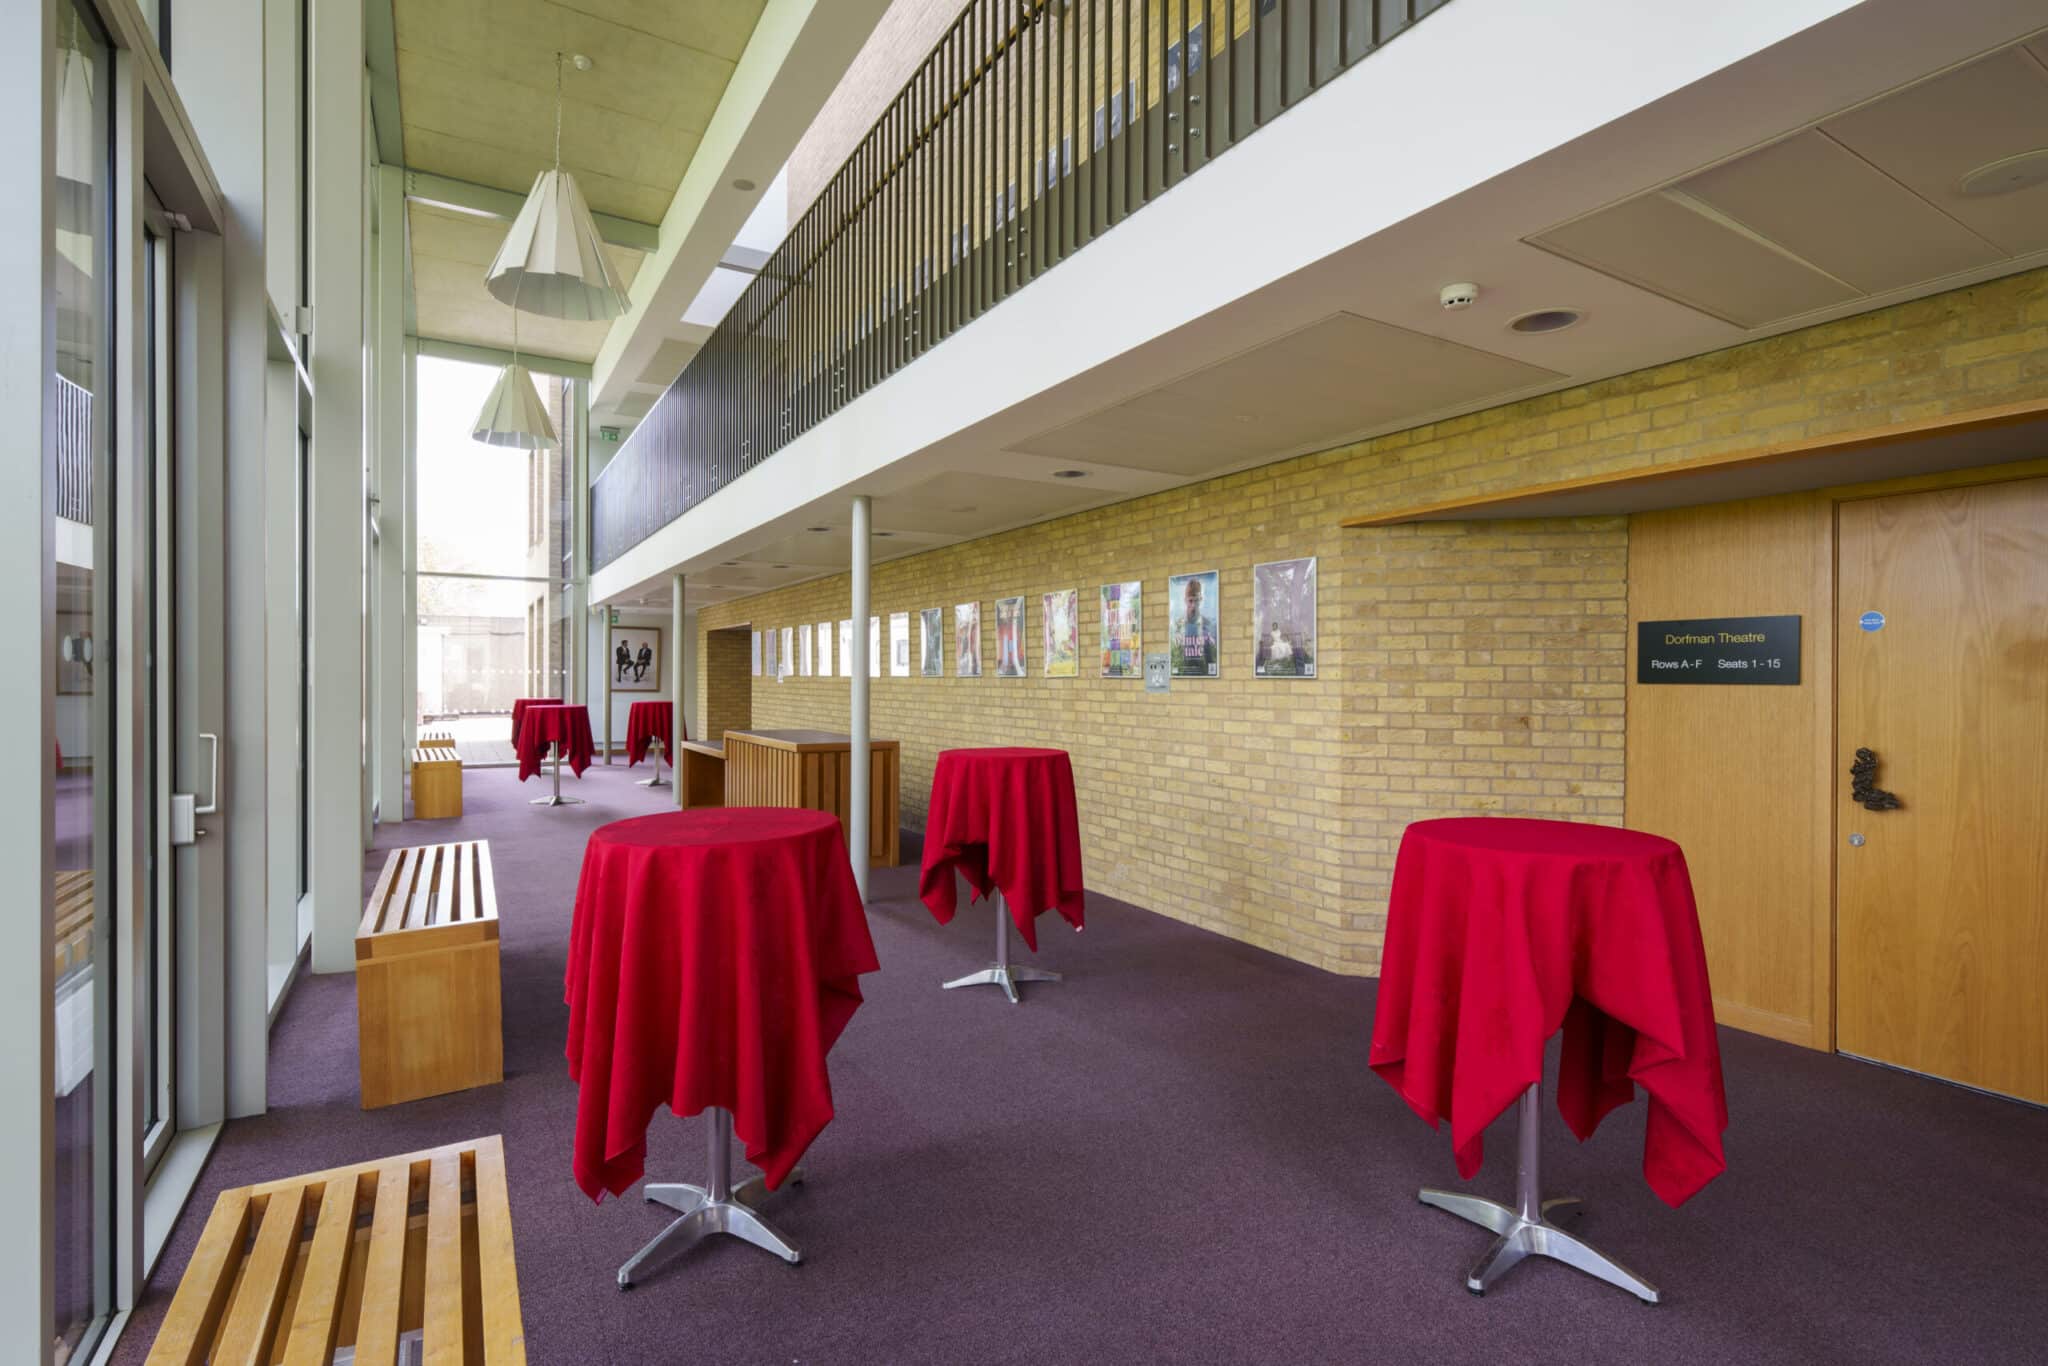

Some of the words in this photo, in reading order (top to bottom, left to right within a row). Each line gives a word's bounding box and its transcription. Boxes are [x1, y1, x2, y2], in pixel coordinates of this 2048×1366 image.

[1665, 633, 1715, 645] Dorfman
[1717, 632, 1766, 644] Theatre
[1651, 659, 1679, 669] Rows
[1717, 658, 1748, 669] Seats
